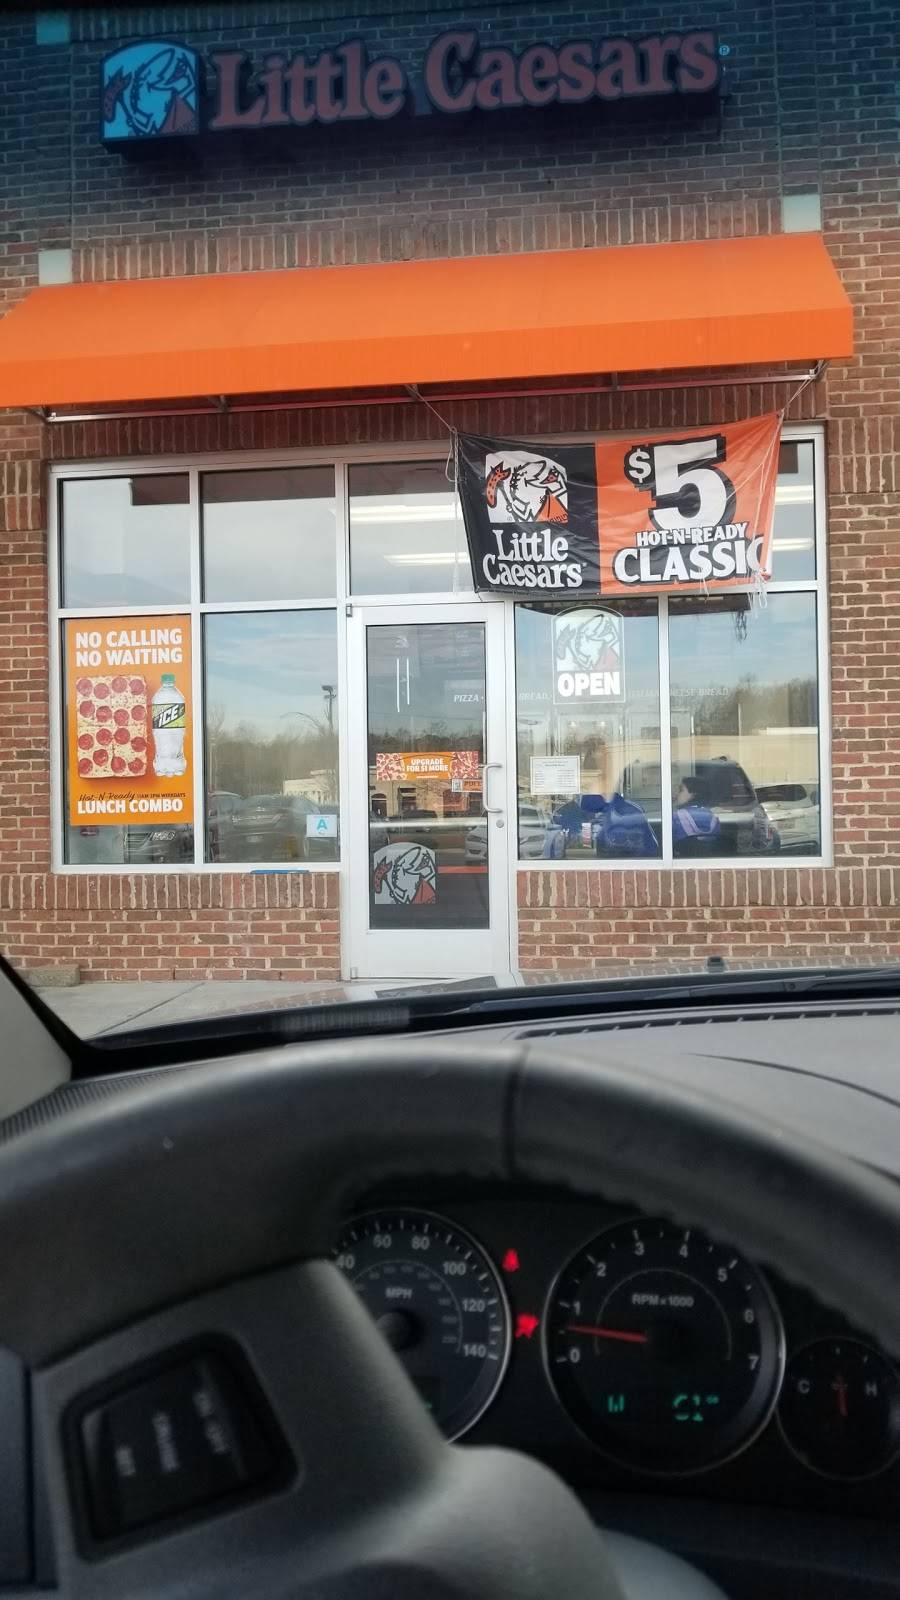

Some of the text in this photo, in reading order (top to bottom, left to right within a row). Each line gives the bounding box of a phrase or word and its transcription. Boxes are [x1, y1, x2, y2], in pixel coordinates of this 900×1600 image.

[212, 33, 717, 127] Little Caesars
[637, 523, 747, 547] HOT-N-READY
[491, 529, 569, 562] Little
[482, 555, 583, 588] Caesars
[76, 628, 183, 649] NO CALLING
[76, 647, 183, 667] NO WAITING
[557, 671, 621, 697] OPEN
[453, 693, 479, 702] PIZZA
[410, 758, 444, 766] UPGRADE
[429, 764, 449, 772] MORE
[77, 798, 184, 814] LUNCH COMBO
[317, 819, 328, 830] A
[373, 1234, 392, 1249] 60
[411, 1236, 431, 1250] 80
[634, 1242, 645, 1257] 3
[679, 1244, 689, 1258] 4
[336, 1254, 355, 1269] 40
[442, 1261, 467, 1276] 100
[596, 1262, 607, 1277] 2
[716, 1268, 728, 1282] 5
[384, 1287, 413, 1299] MPH
[462, 1300, 486, 1313] 120
[572, 1300, 582, 1316] 1
[744, 1310, 755, 1324] 6
[463, 1344, 487, 1358] 140
[569, 1347, 581, 1364] 0
[748, 1355, 759, 1371] 7
[798, 1379, 810, 1394] C
[866, 1381, 878, 1397] H
